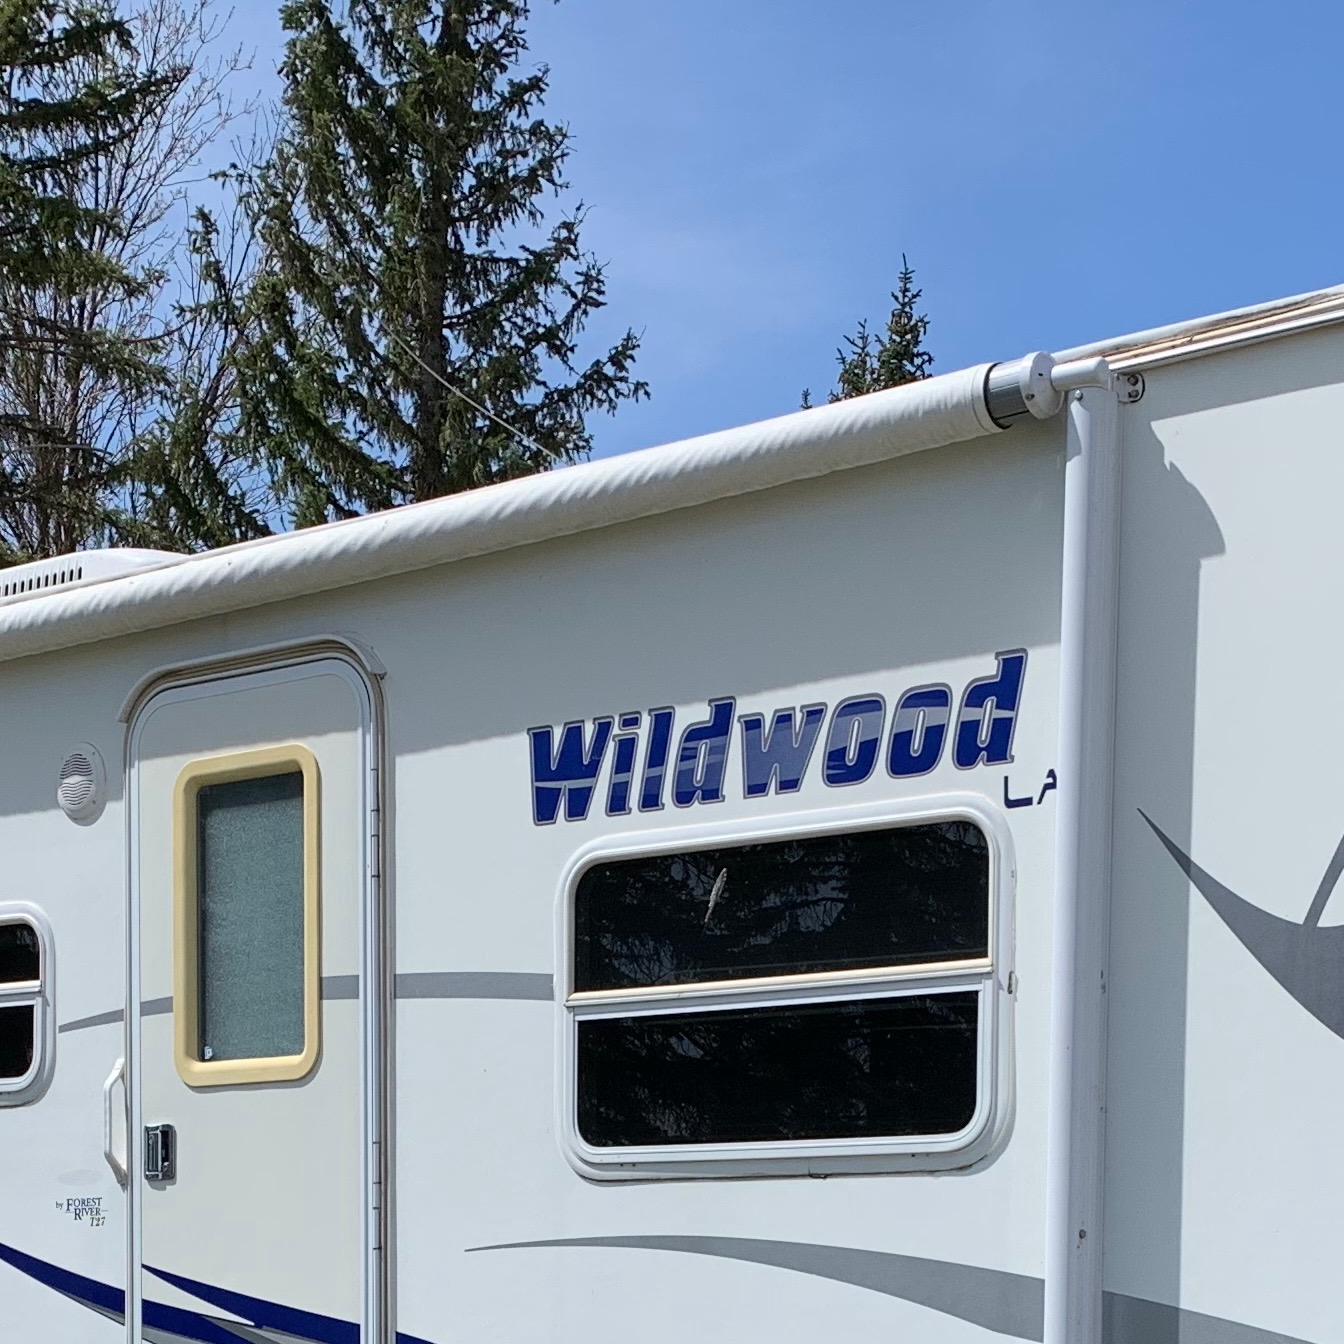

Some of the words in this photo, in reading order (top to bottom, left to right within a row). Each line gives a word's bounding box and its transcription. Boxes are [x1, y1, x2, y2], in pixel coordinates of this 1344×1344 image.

[527, 647, 1028, 826] Wildwood
[56, 1201, 64, 1210] by
[66, 1197, 102, 1211] FOREST
[74, 1208, 101, 1220] RIVER
